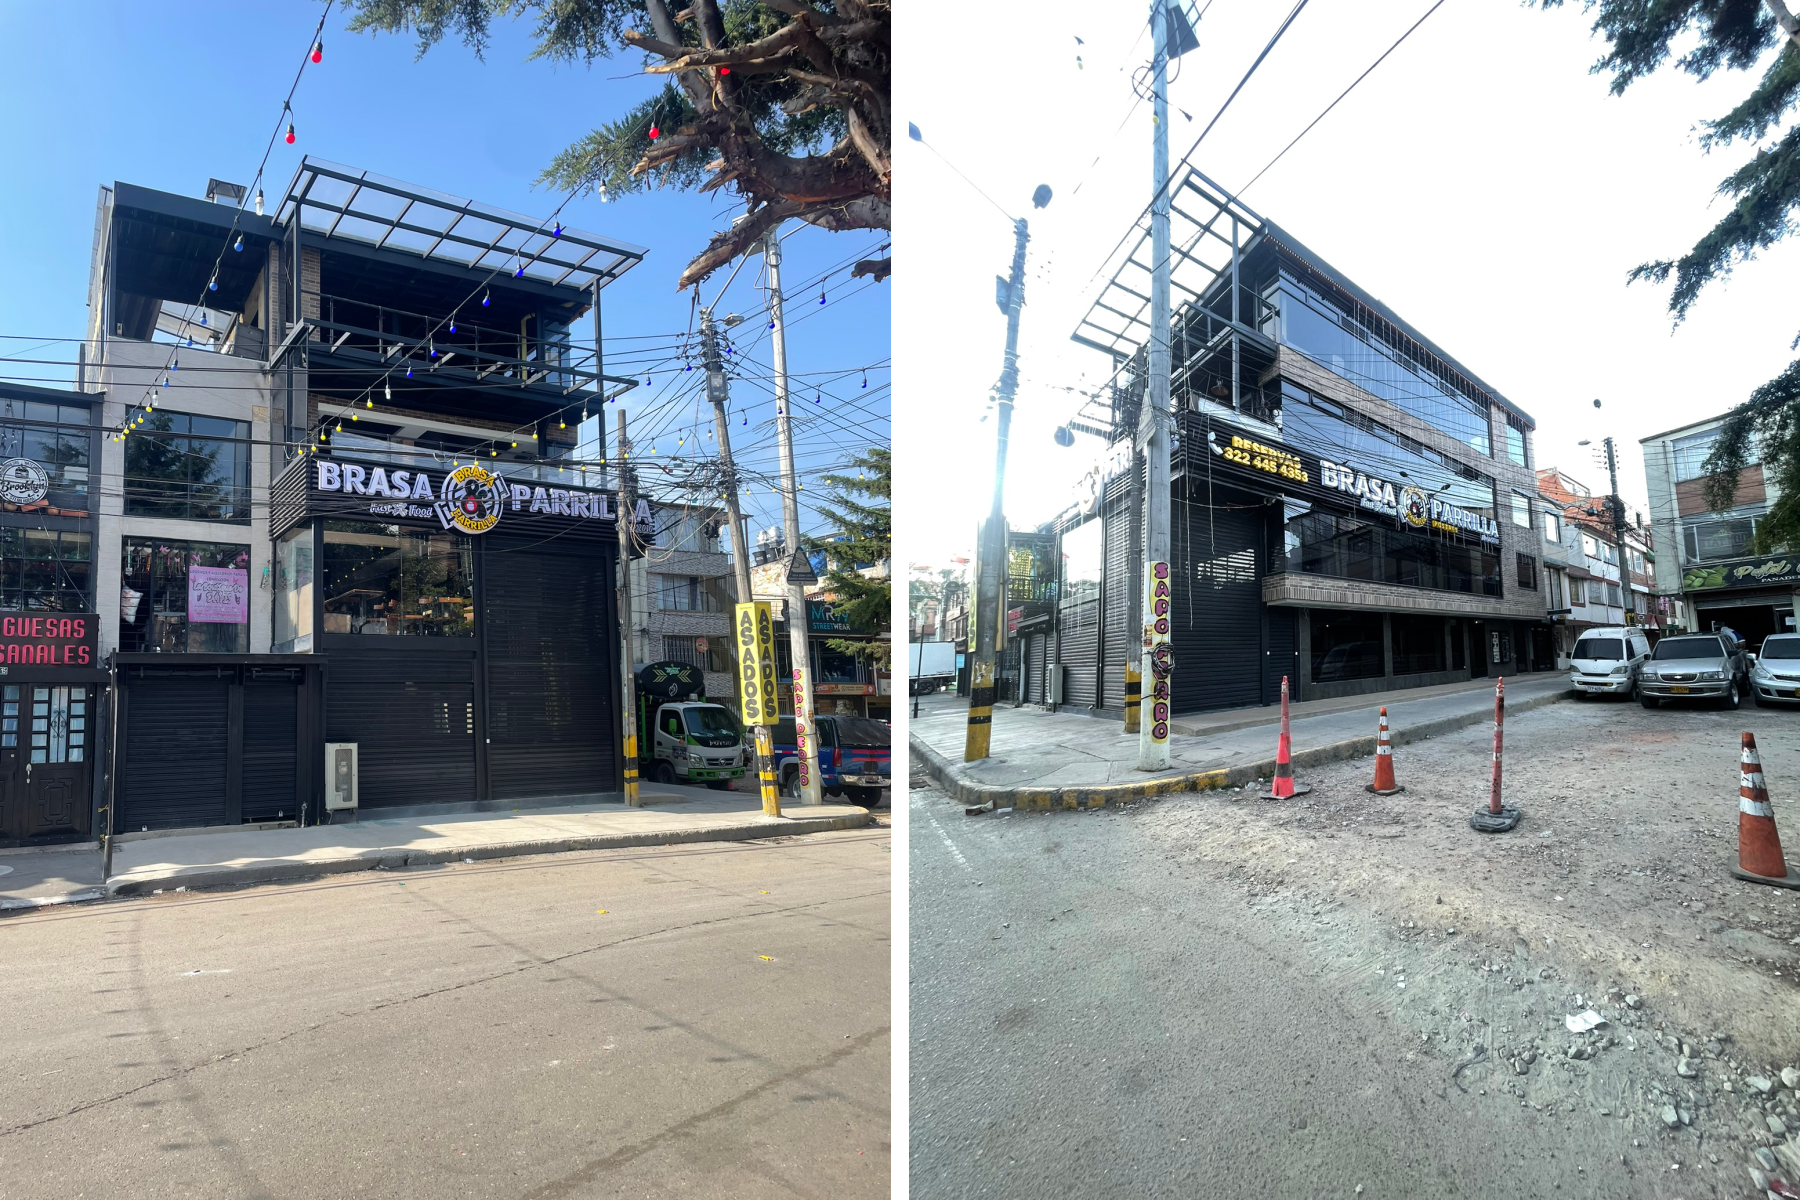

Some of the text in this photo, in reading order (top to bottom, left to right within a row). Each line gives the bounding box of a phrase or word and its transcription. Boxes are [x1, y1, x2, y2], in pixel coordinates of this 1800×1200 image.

[1223, 446, 1309, 483] 322 445 4353
[1231, 435, 1302, 469] RESERVAS
[316, 460, 435, 500] BRASA
[452, 466, 495, 489] BRASA
[1320, 459, 1397, 508] BRASA
[408, 504, 433, 518] Food
[450, 507, 498, 530] PARRILLA
[510, 483, 653, 524] PARRILA
[1430, 498, 1499, 537] PARRILLA
[1154, 562, 1169, 634] SAPO
[812, 622, 851, 631] STREETWEAR
[740, 610, 760, 718] ASADOS
[759, 608, 776, 718] ASADOS
